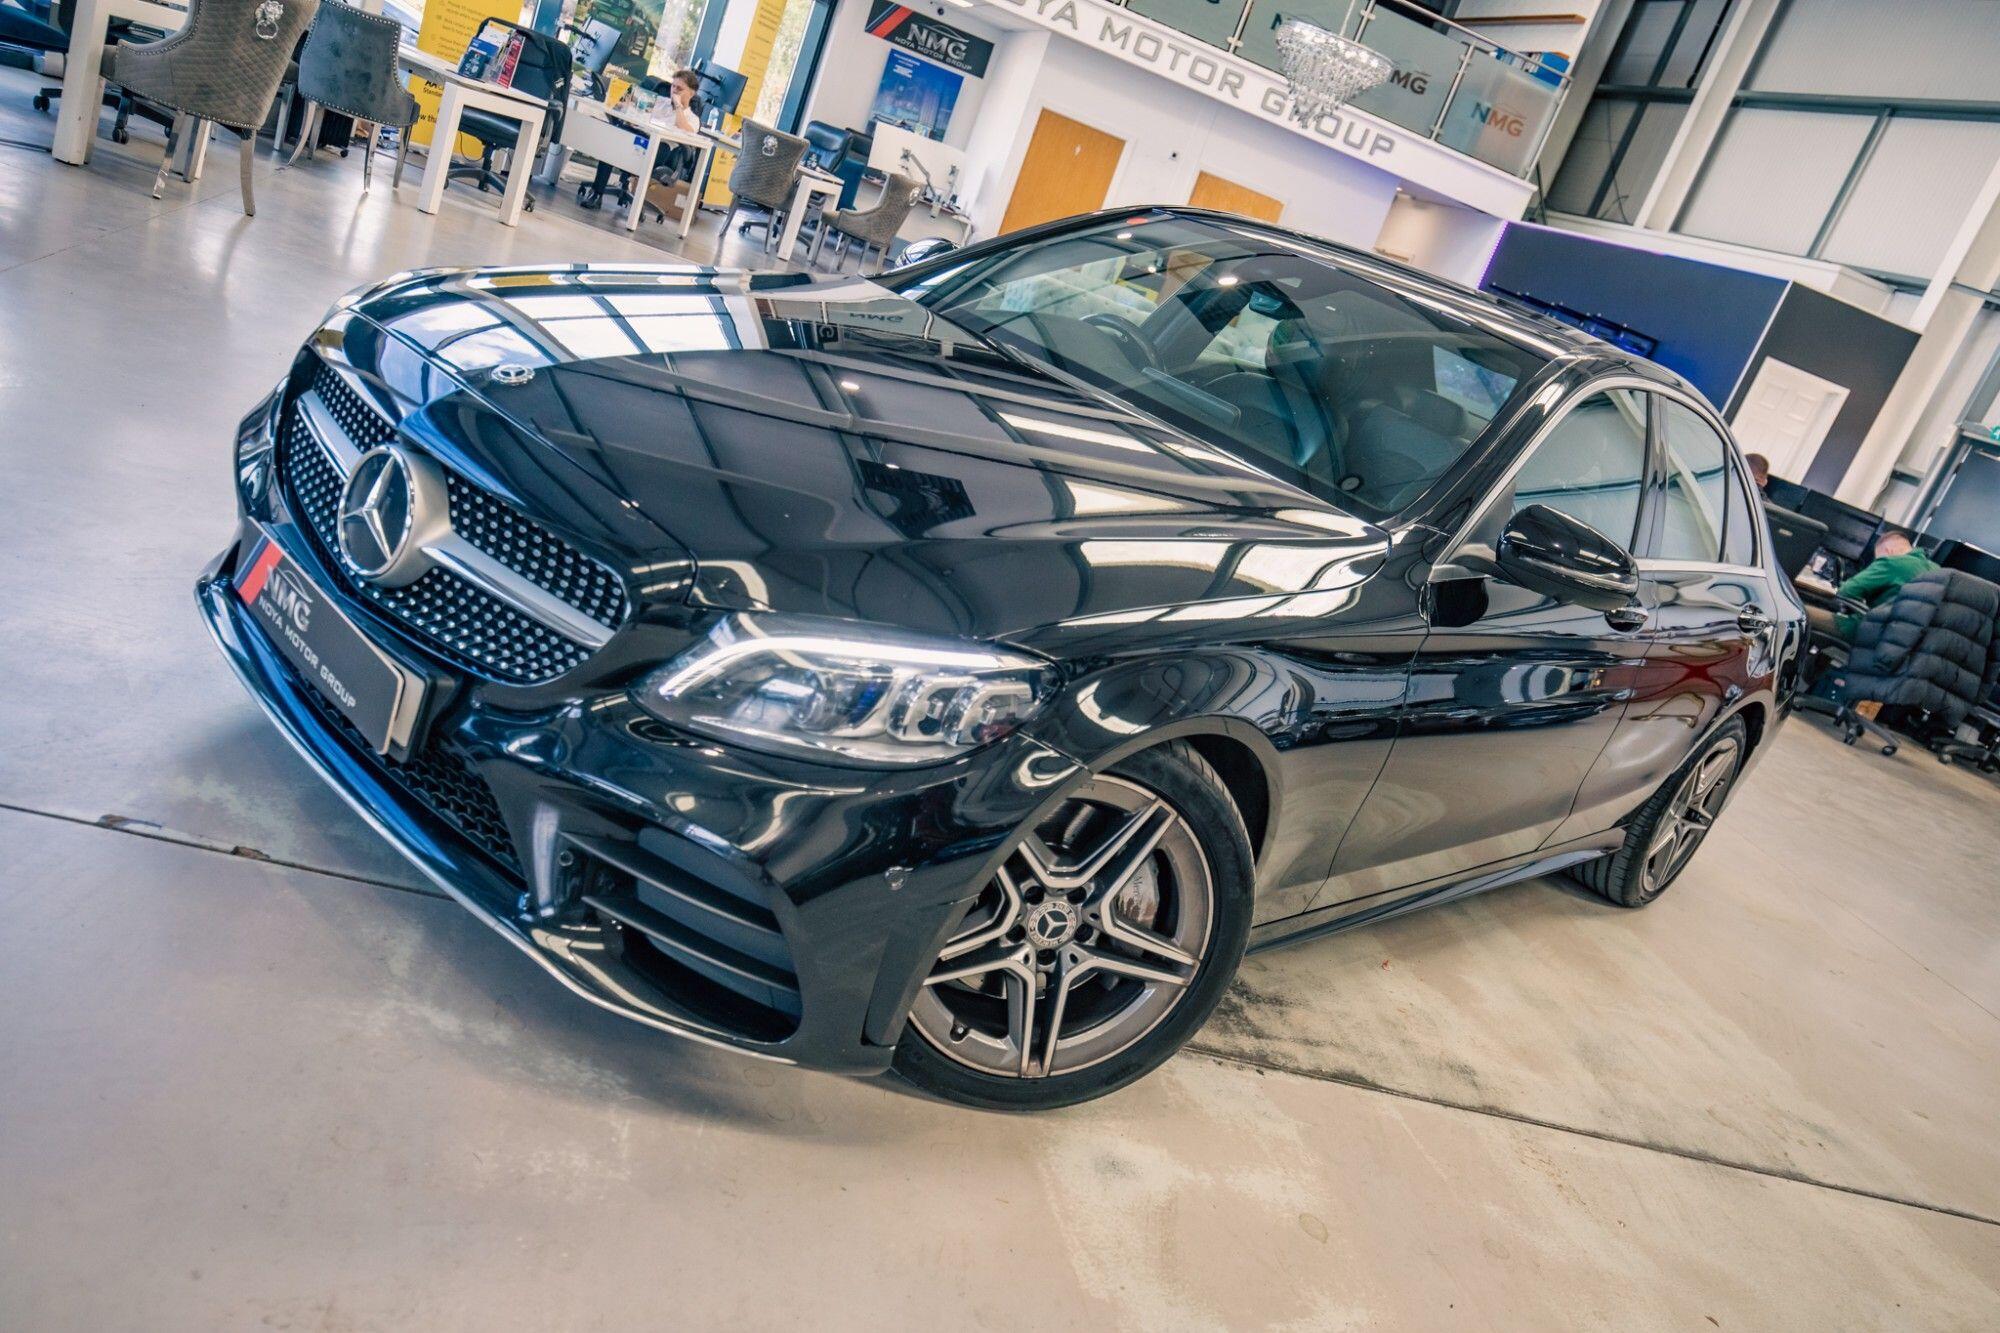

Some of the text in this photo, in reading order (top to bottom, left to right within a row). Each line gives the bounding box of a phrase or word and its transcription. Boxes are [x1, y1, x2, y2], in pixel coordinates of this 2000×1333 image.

[894, 36, 972, 71] NOYA MOTOR GROUP
[907, 23, 967, 60] NMG
[1099, 16, 1245, 99] MOTOR
[1261, 87, 1395, 156] GOUP
[1389, 69, 1428, 95] MG
[1471, 102, 1525, 137] NMG
[263, 565, 311, 632] NMG
[259, 596, 356, 708] NOYA MOTOR GROUP
